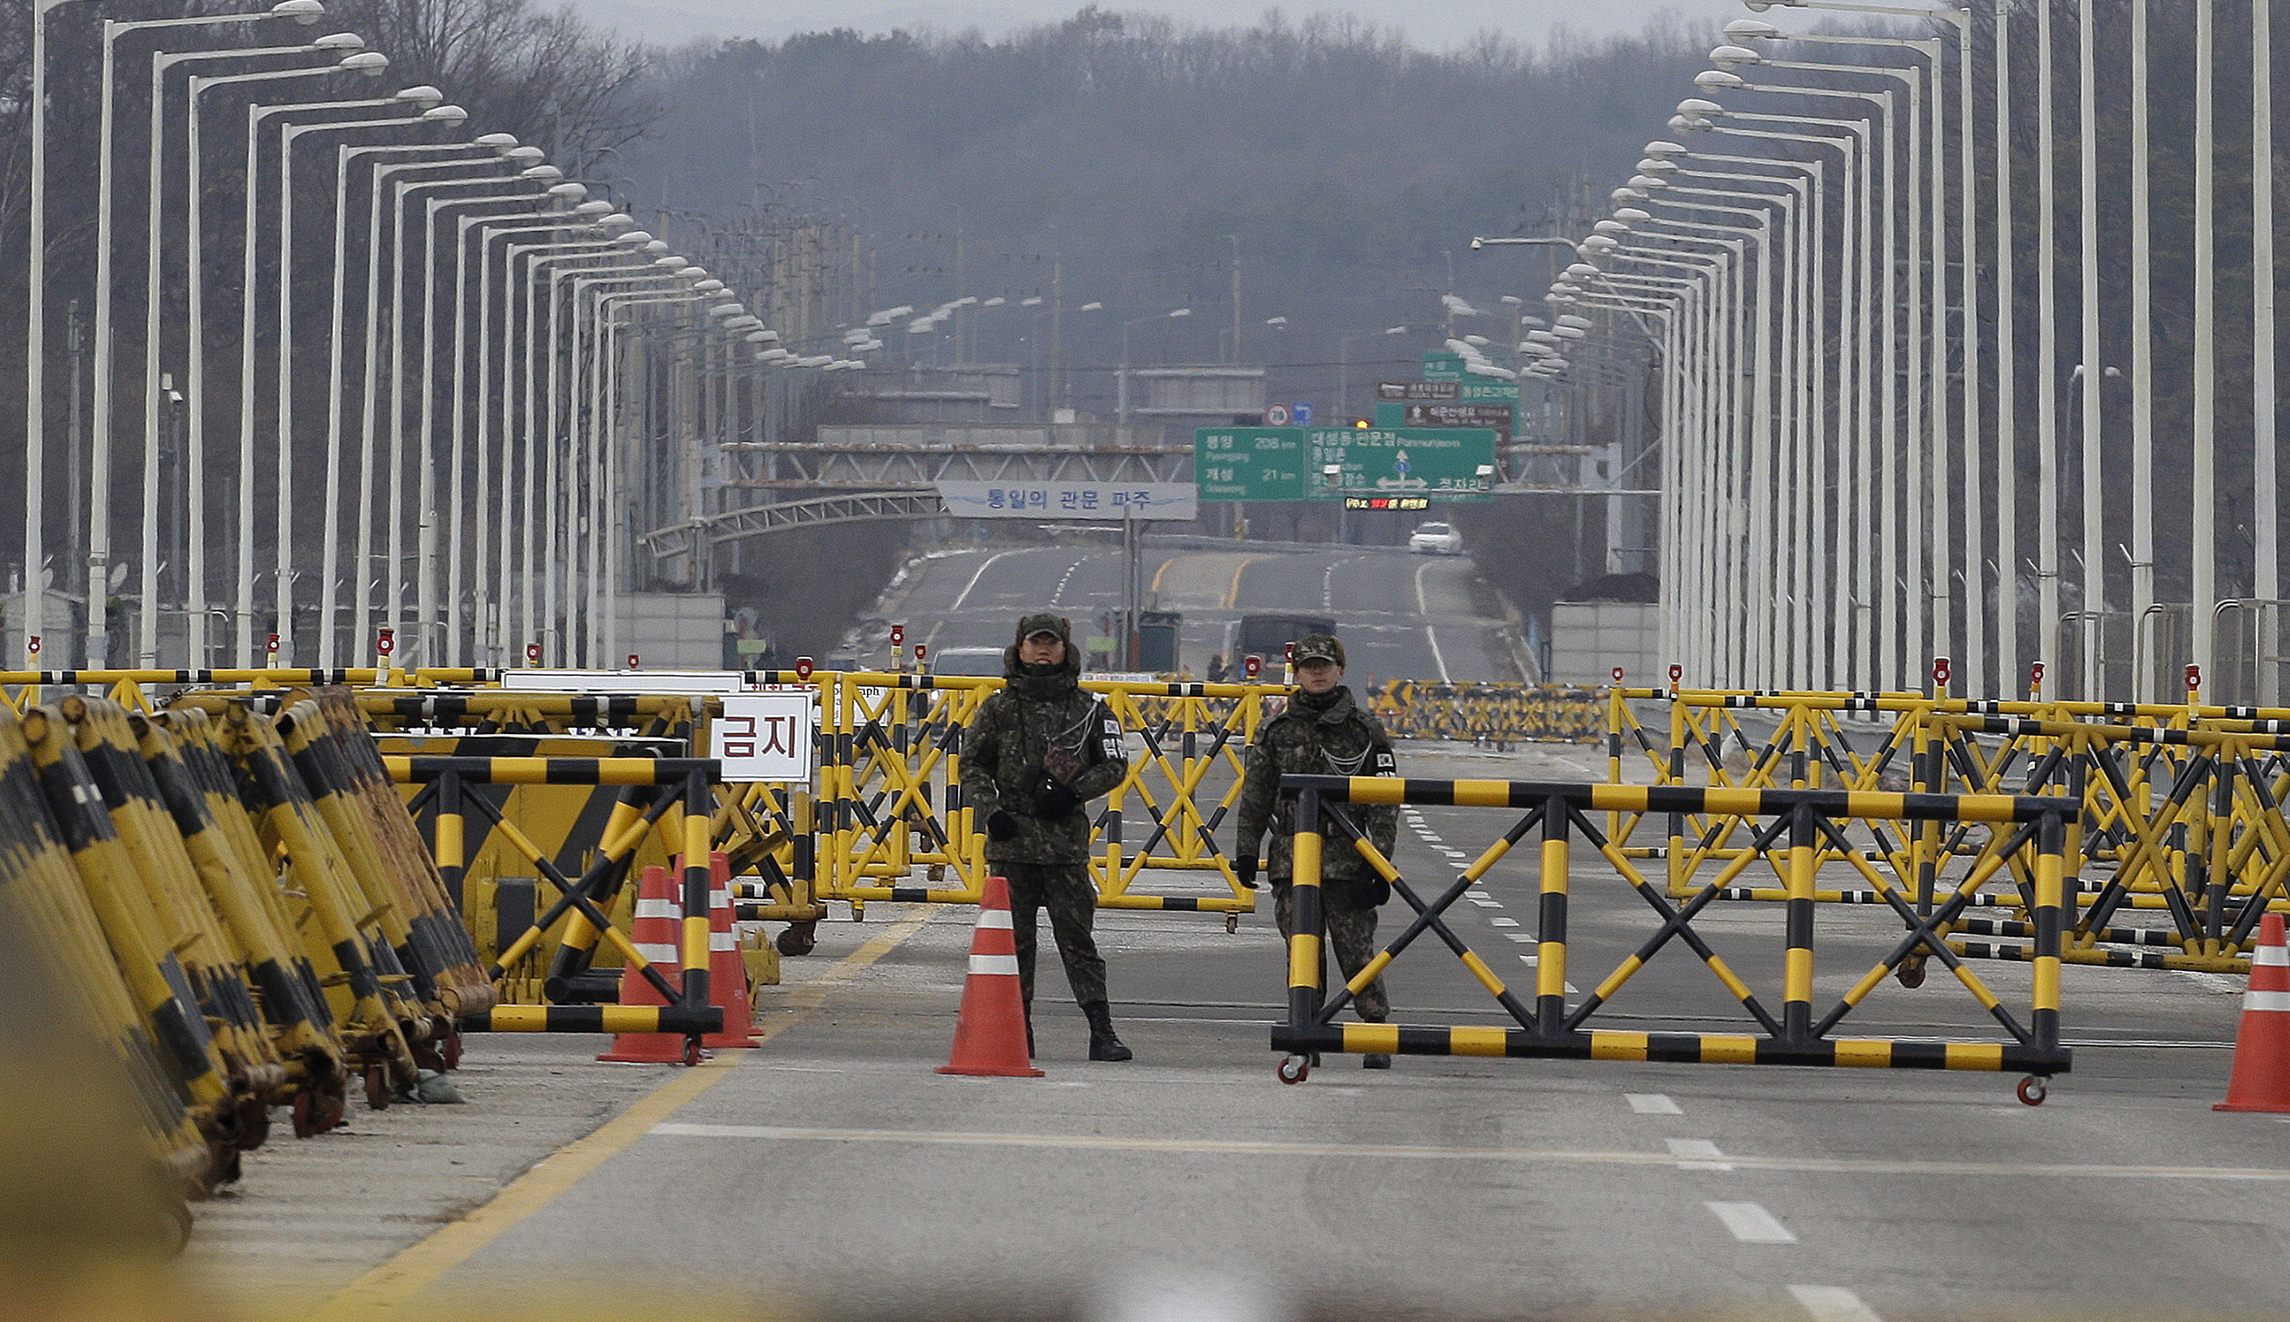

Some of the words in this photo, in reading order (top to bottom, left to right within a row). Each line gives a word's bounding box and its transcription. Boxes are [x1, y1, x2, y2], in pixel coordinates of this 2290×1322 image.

[1206, 435, 1234, 449] 평양
[1255, 437, 1279, 449] 208
[1311, 431, 1351, 446] 대성동
[1356, 432, 1396, 446] 판문점
[1205, 467, 1234, 481] 개성
[1262, 469, 1276, 481] 21
[987, 489, 1048, 509] 통일의
[1061, 490, 1098, 509] 관문
[1111, 490, 1151, 510] 파주
[722, 715, 796, 759] 금지
